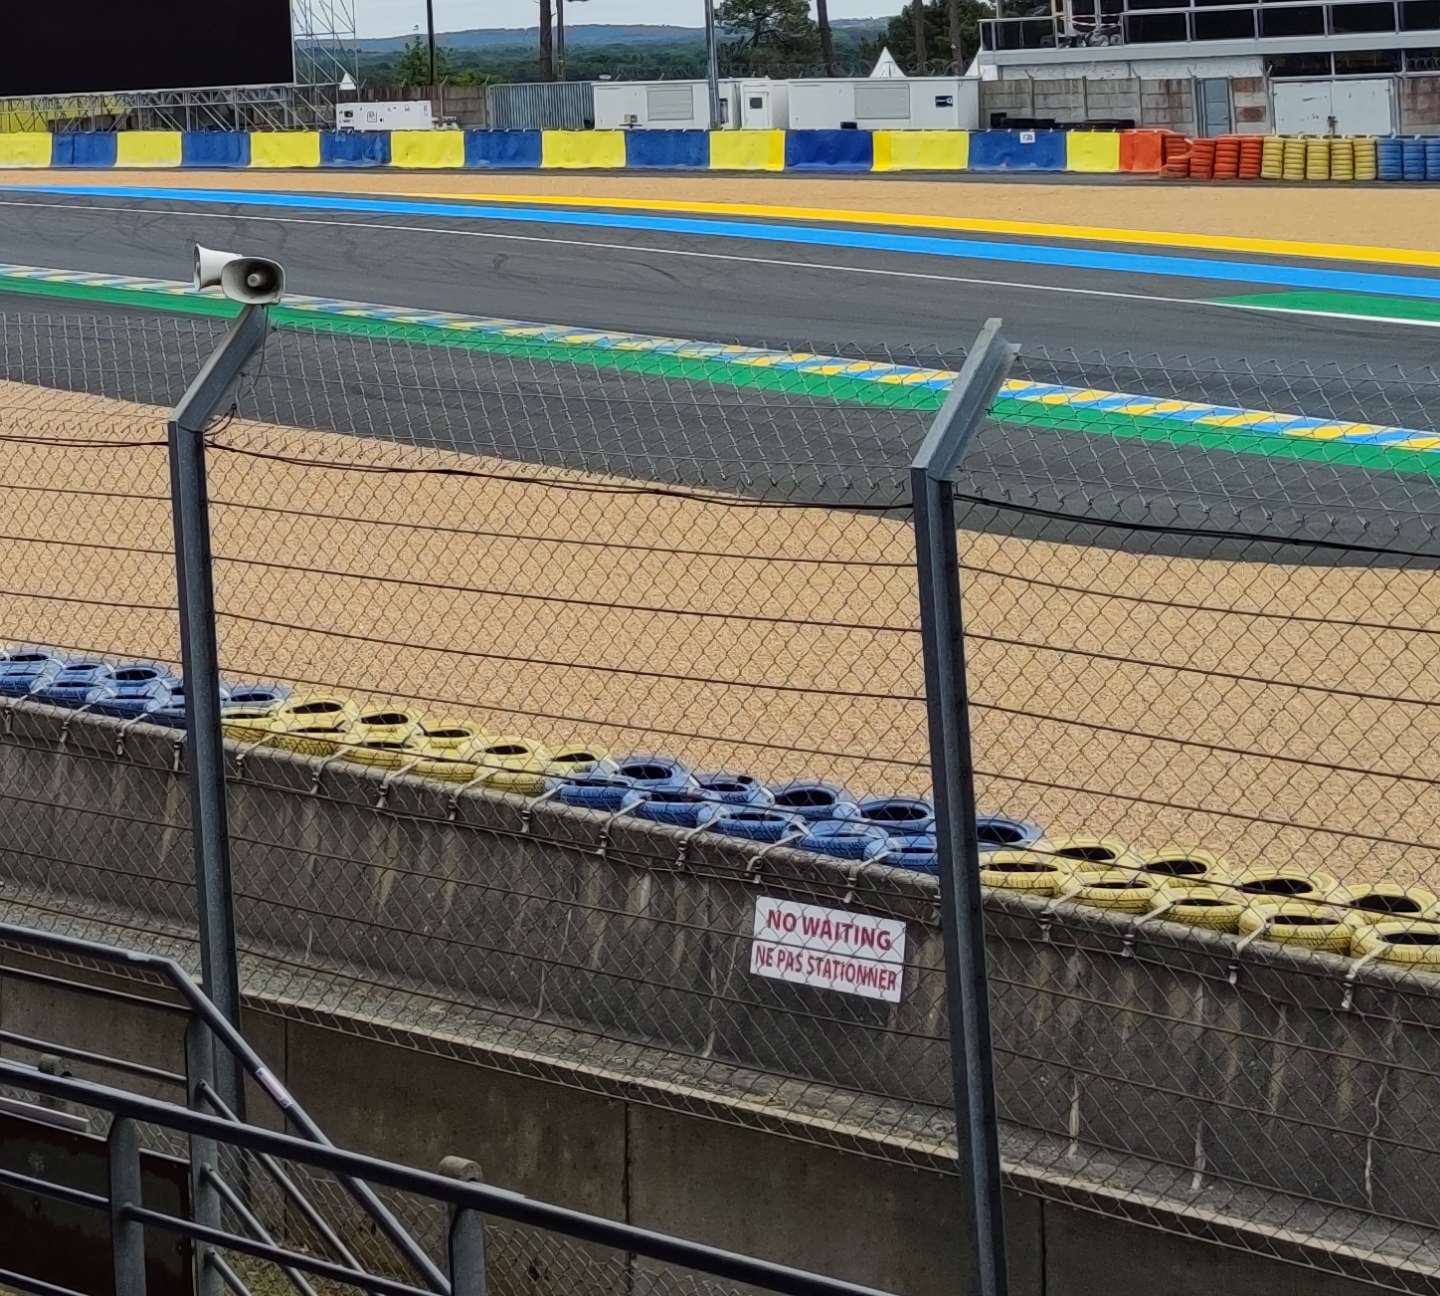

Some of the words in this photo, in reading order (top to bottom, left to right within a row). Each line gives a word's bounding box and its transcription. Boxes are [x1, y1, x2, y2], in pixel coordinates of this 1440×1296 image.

[767, 909, 797, 932] NO
[802, 916, 892, 951] WAITING
[755, 945, 774, 967] NE
[777, 949, 803, 973] PAS
[807, 955, 897, 991] STATIONNER
